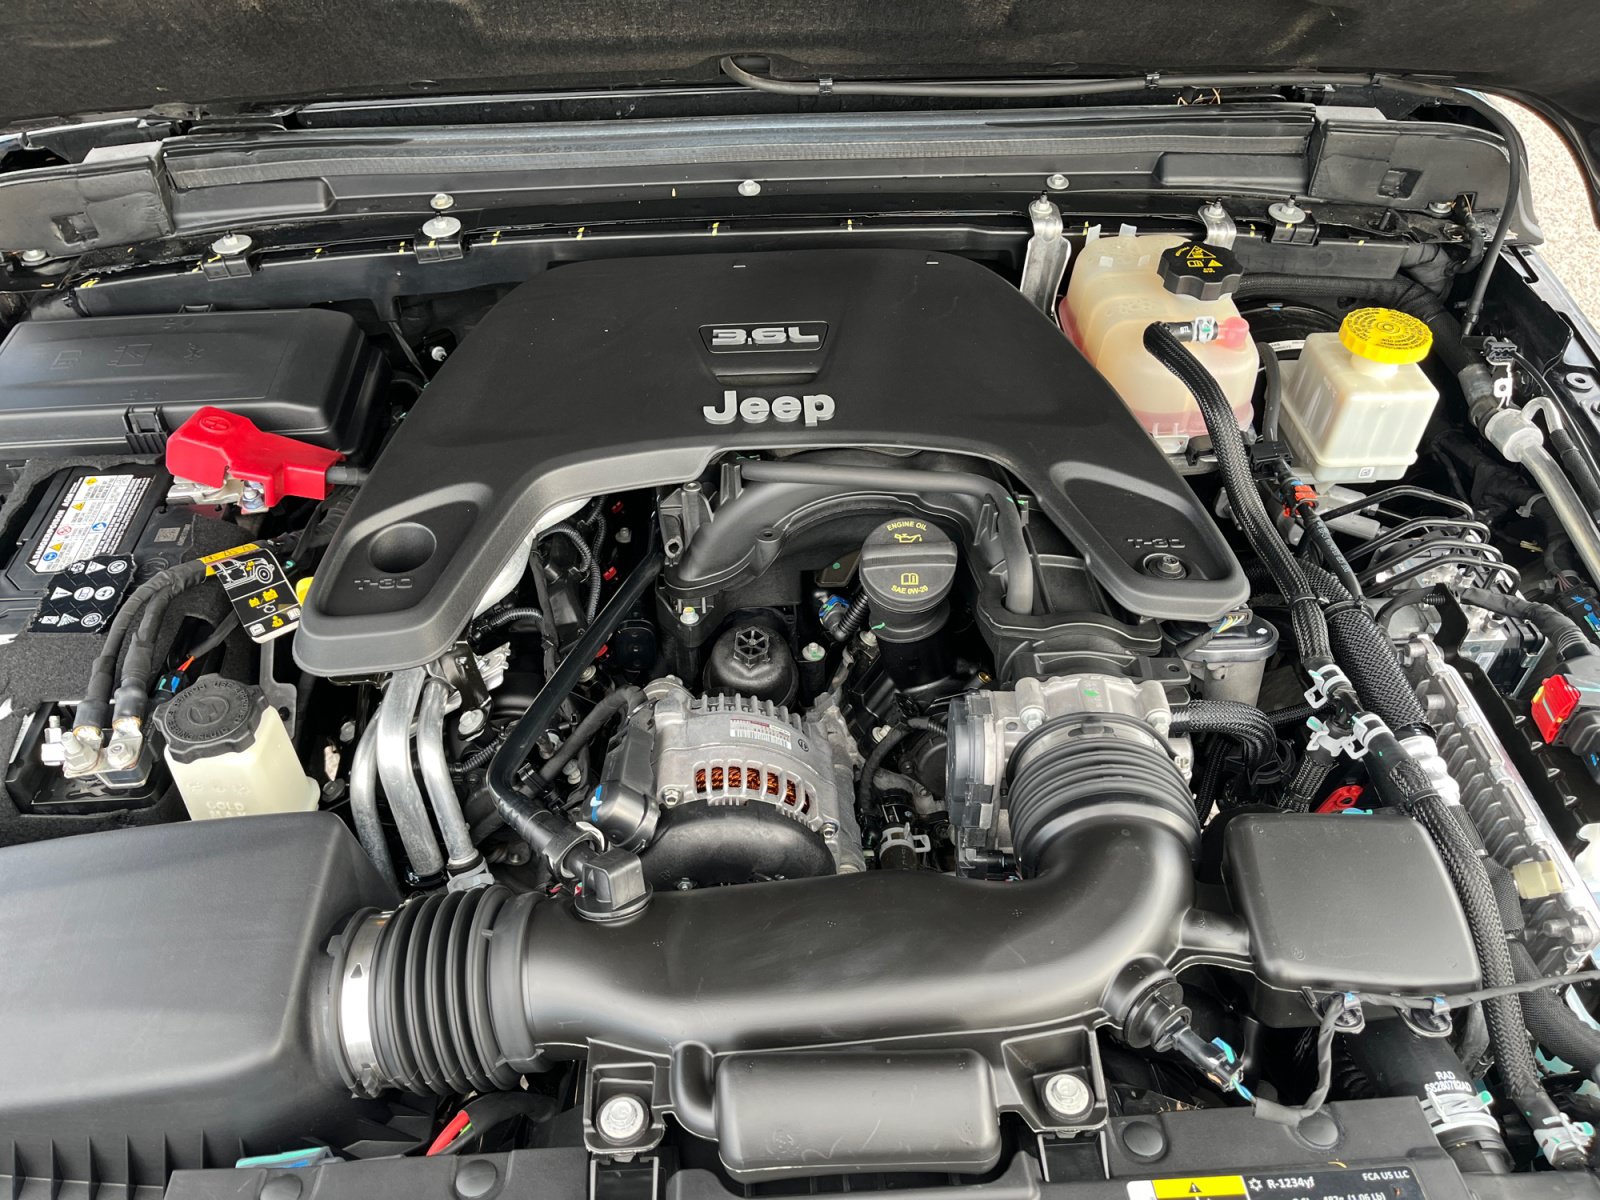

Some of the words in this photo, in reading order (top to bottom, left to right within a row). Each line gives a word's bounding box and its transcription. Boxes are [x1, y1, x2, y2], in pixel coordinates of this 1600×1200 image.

[712, 326, 820, 345] 3.6L
[703, 390, 836, 427] Jeep
[886, 521, 915, 531] ENGINE
[915, 522, 928, 531] OIL
[891, 584, 906, 594] SAE
[907, 584, 929, 595] 0W-20
[206, 800, 245, 811] COLD
[1434, 1070, 1456, 1080] RAD
[1361, 1172, 1379, 1181] FCA
[1380, 1171, 1394, 1180] US
[1393, 1170, 1410, 1179] LLC
[1266, 1176, 1315, 1189] R-1234yf
